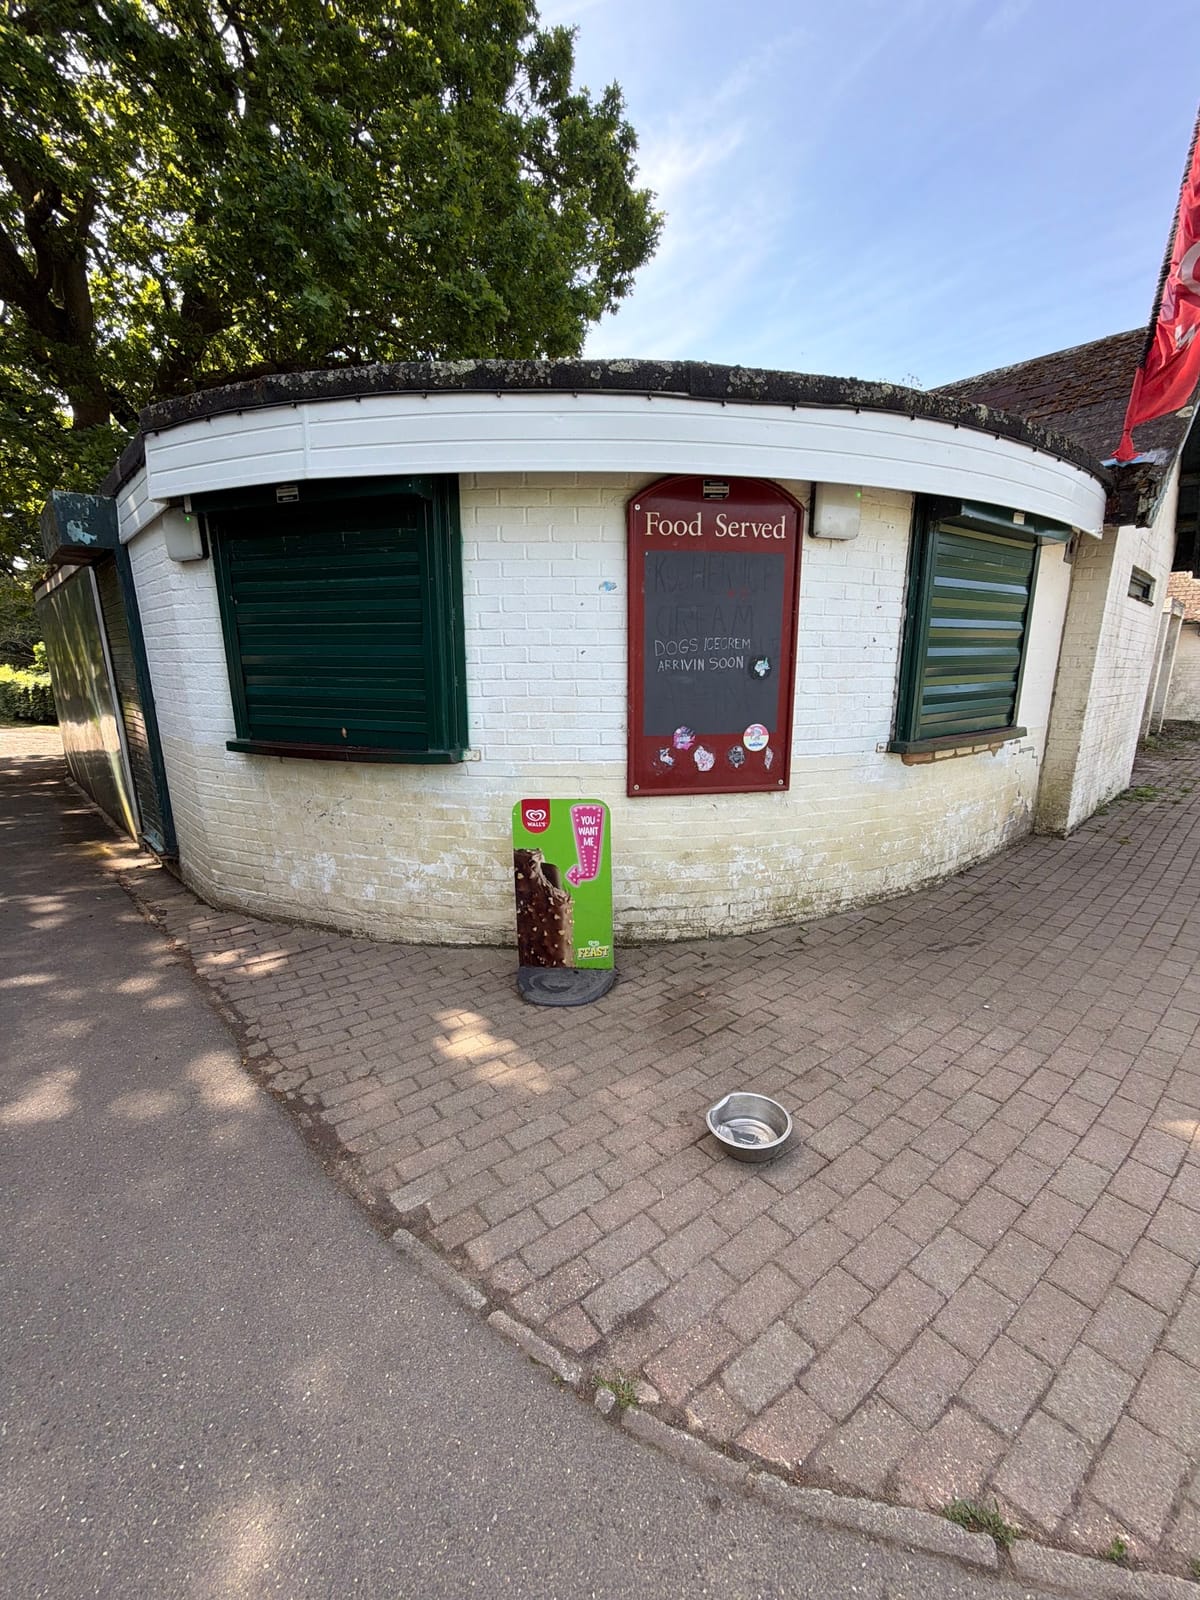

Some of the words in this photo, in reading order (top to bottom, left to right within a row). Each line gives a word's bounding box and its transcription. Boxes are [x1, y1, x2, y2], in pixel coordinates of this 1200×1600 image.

[645, 511, 703, 536] Food
[715, 513, 786, 539] Served
[654, 638, 698, 657] DOGS
[703, 637, 751, 651] ICECREM
[657, 658, 705, 672] ARRIVIN
[709, 656, 744, 671] SOON
[580, 815, 595, 825] YOU
[578, 827, 598, 836] WANT
[583, 837, 594, 847] ME
[577, 945, 609, 960] FEAST
